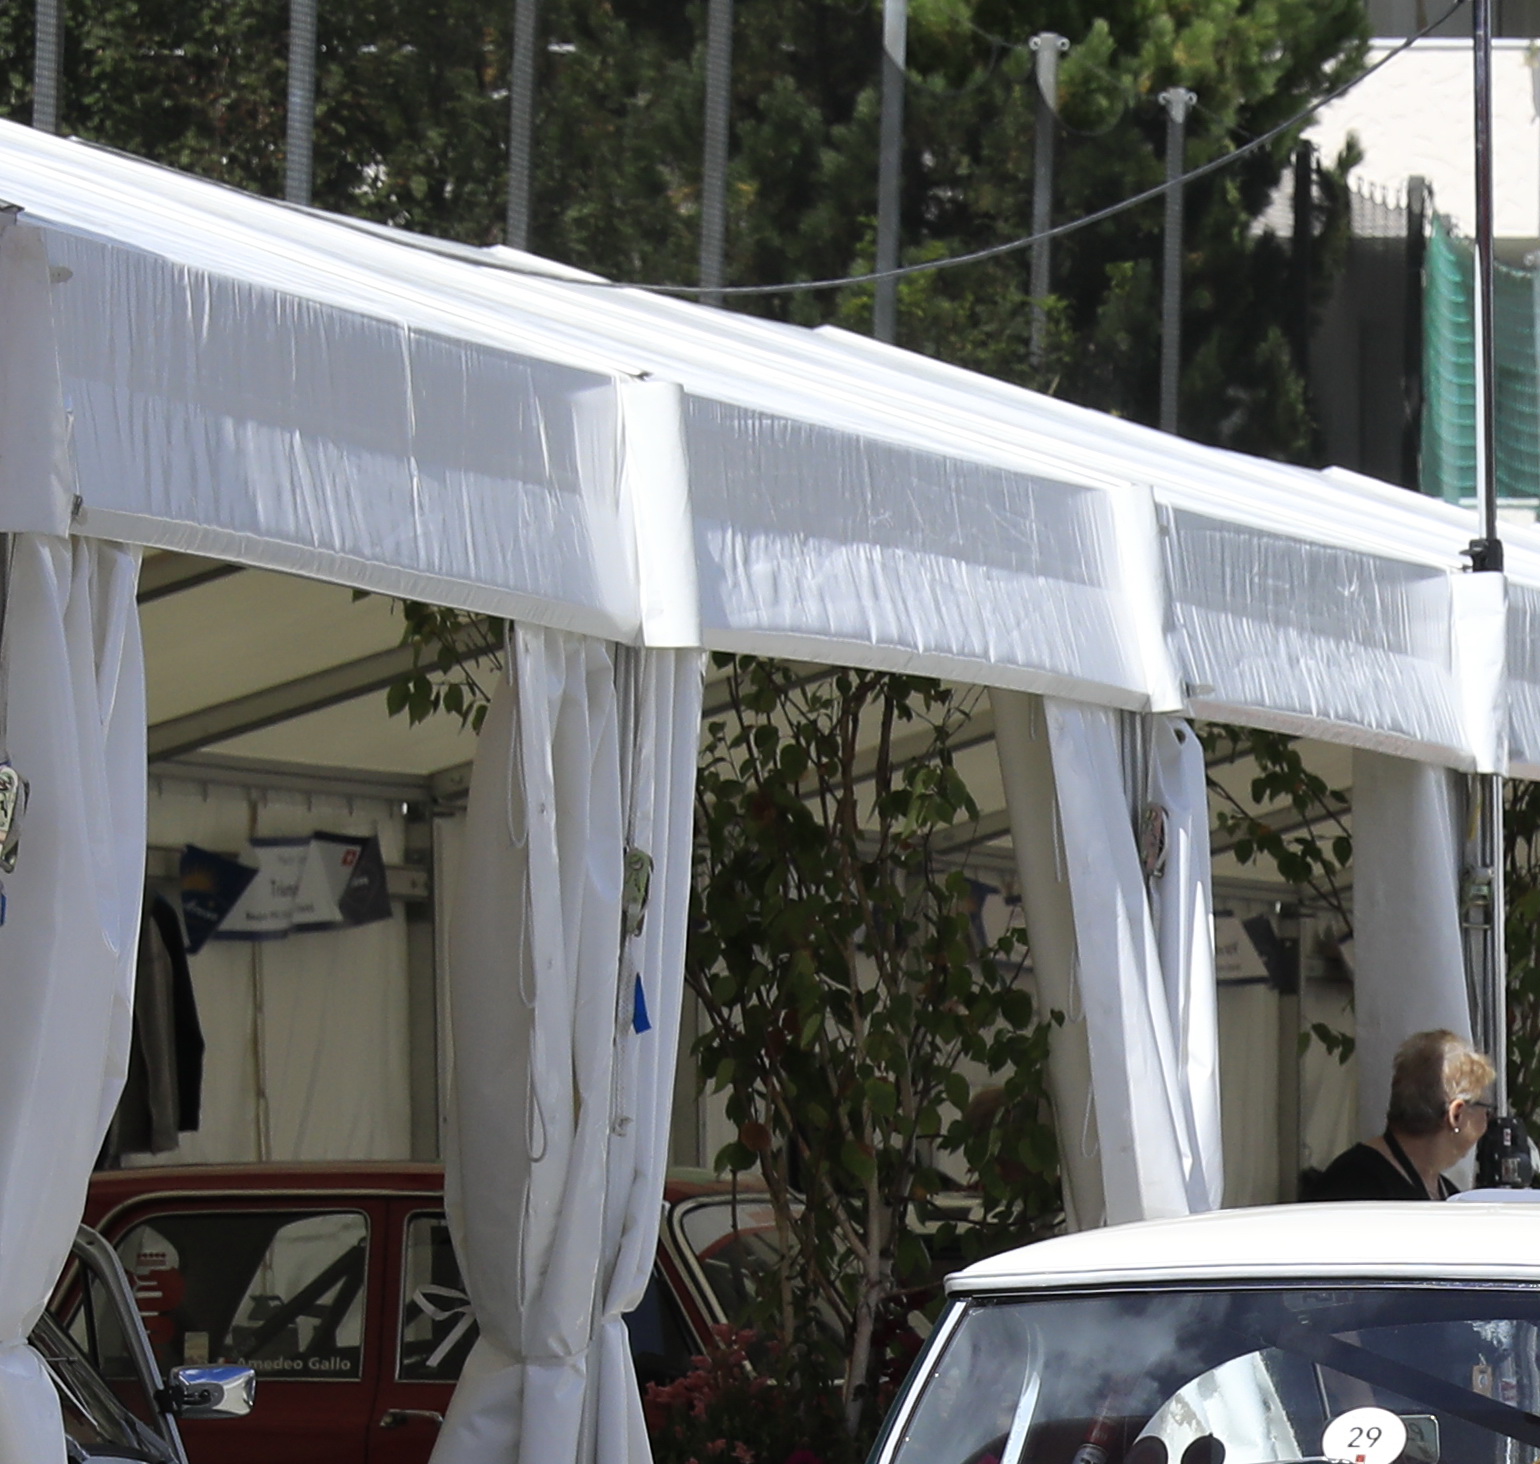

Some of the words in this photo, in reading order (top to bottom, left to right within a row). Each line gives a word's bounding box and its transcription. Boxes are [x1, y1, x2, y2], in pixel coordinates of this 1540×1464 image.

[237, 1356, 303, 1370] Amedeo
[308, 1356, 351, 1370] Gallo
[1347, 1426, 1383, 1449] 29
